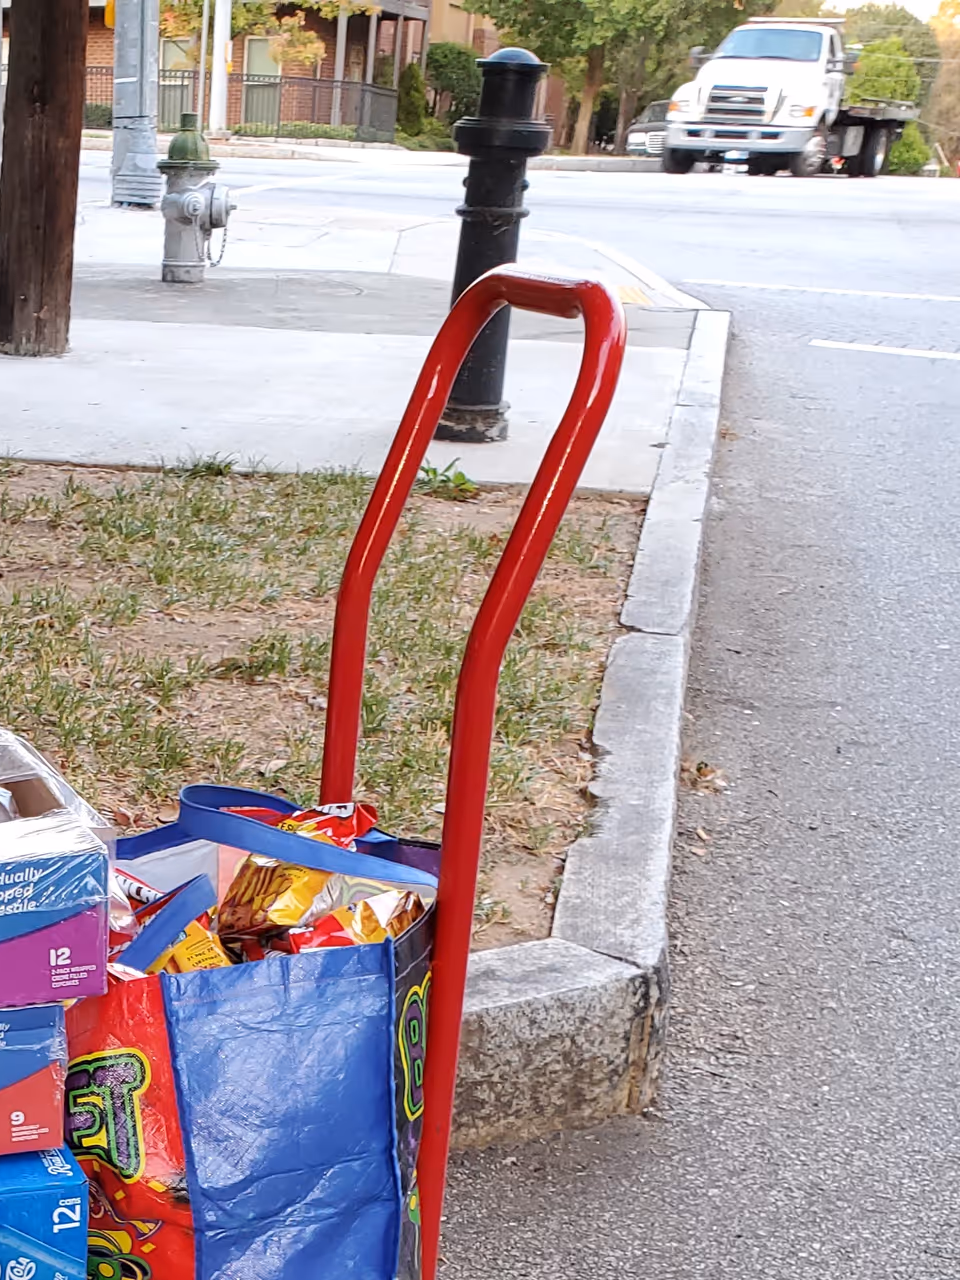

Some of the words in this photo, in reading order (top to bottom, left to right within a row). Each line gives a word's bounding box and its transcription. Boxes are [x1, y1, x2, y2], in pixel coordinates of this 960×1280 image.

[50, 947, 71, 966] 12
[11, 1112, 25, 1125] 9
[65, 1047, 149, 1184] ET
[59, 1197, 82, 1206] cans
[53, 1205, 81, 1234] 12
